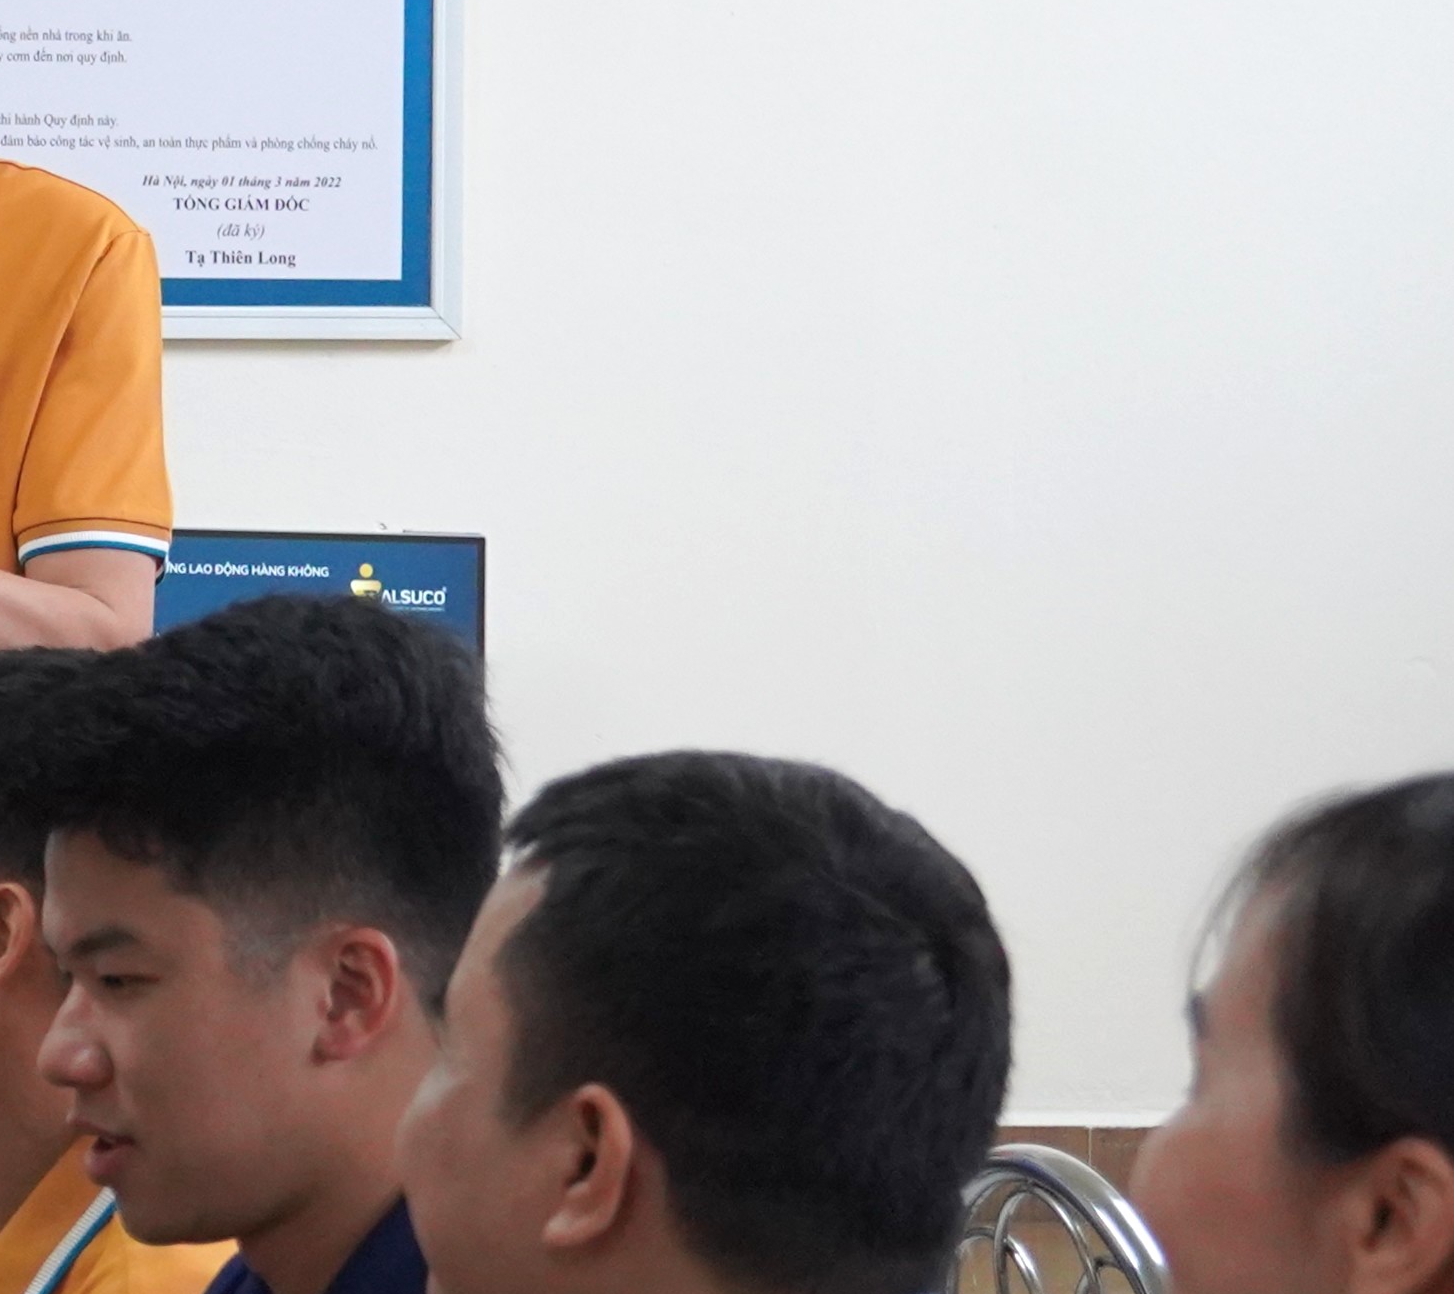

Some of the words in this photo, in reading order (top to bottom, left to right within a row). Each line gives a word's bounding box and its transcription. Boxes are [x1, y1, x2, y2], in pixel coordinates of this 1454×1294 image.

[142, 174, 160, 187] Hà
[190, 175, 219, 190] ngày
[221, 175, 236, 187] 01
[238, 175, 272, 191] tháng
[274, 175, 283, 188] 3
[284, 176, 311, 188] năm
[313, 176, 342, 188] 2022
[225, 195, 269, 210] GIÁM
[217, 223, 240, 239] (đã
[244, 223, 265, 240] ký)
[186, 251, 204, 267] Tạ
[210, 251, 252, 264] Thiên
[259, 251, 296, 267] Long
[189, 564, 212, 575] LAO
[215, 562, 249, 577] ĐỘNG
[252, 562, 285, 577] HÀNG
[288, 564, 329, 578] KHÔNG
[381, 589, 446, 606] ALSUCO
